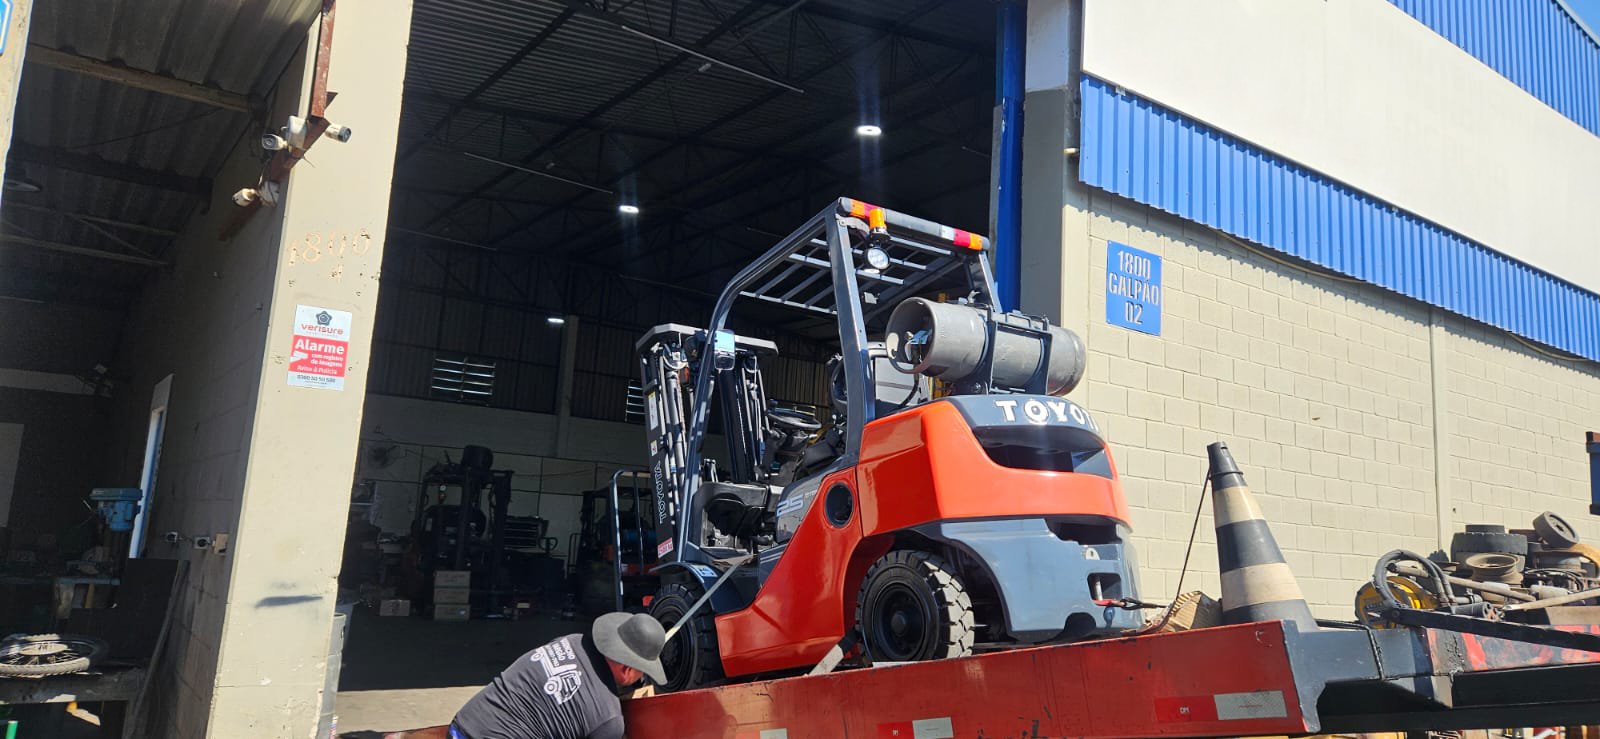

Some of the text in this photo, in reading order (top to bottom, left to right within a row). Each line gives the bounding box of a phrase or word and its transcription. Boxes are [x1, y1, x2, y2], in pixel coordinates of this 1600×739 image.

[1117, 250, 1151, 279] 1800
[1125, 301, 1143, 325] 02
[301, 323, 344, 335] verisure
[295, 338, 345, 354] Alarme
[776, 494, 804, 517] 25
